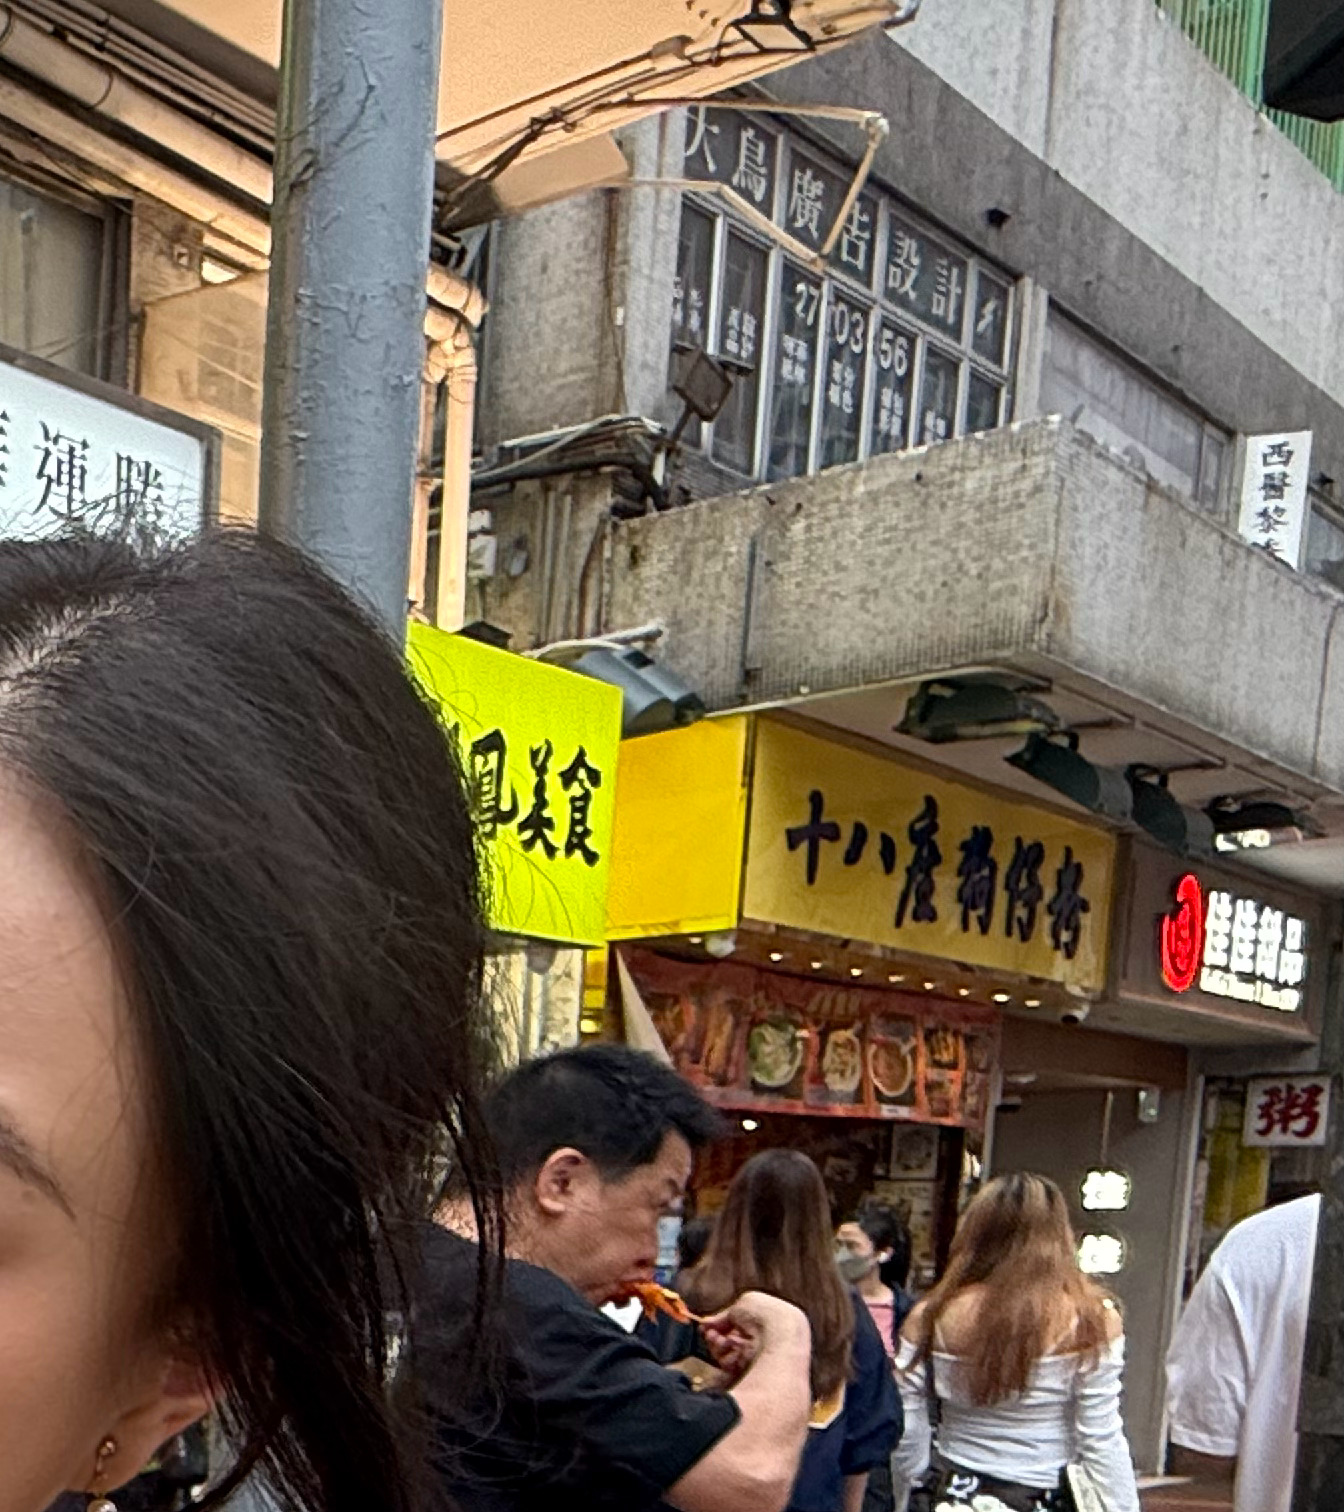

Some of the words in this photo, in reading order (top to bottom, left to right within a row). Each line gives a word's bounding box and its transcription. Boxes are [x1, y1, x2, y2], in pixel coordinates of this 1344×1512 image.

[450, 720, 603, 868] 鳳美食
[1255, 1084, 1326, 1139] 粥
